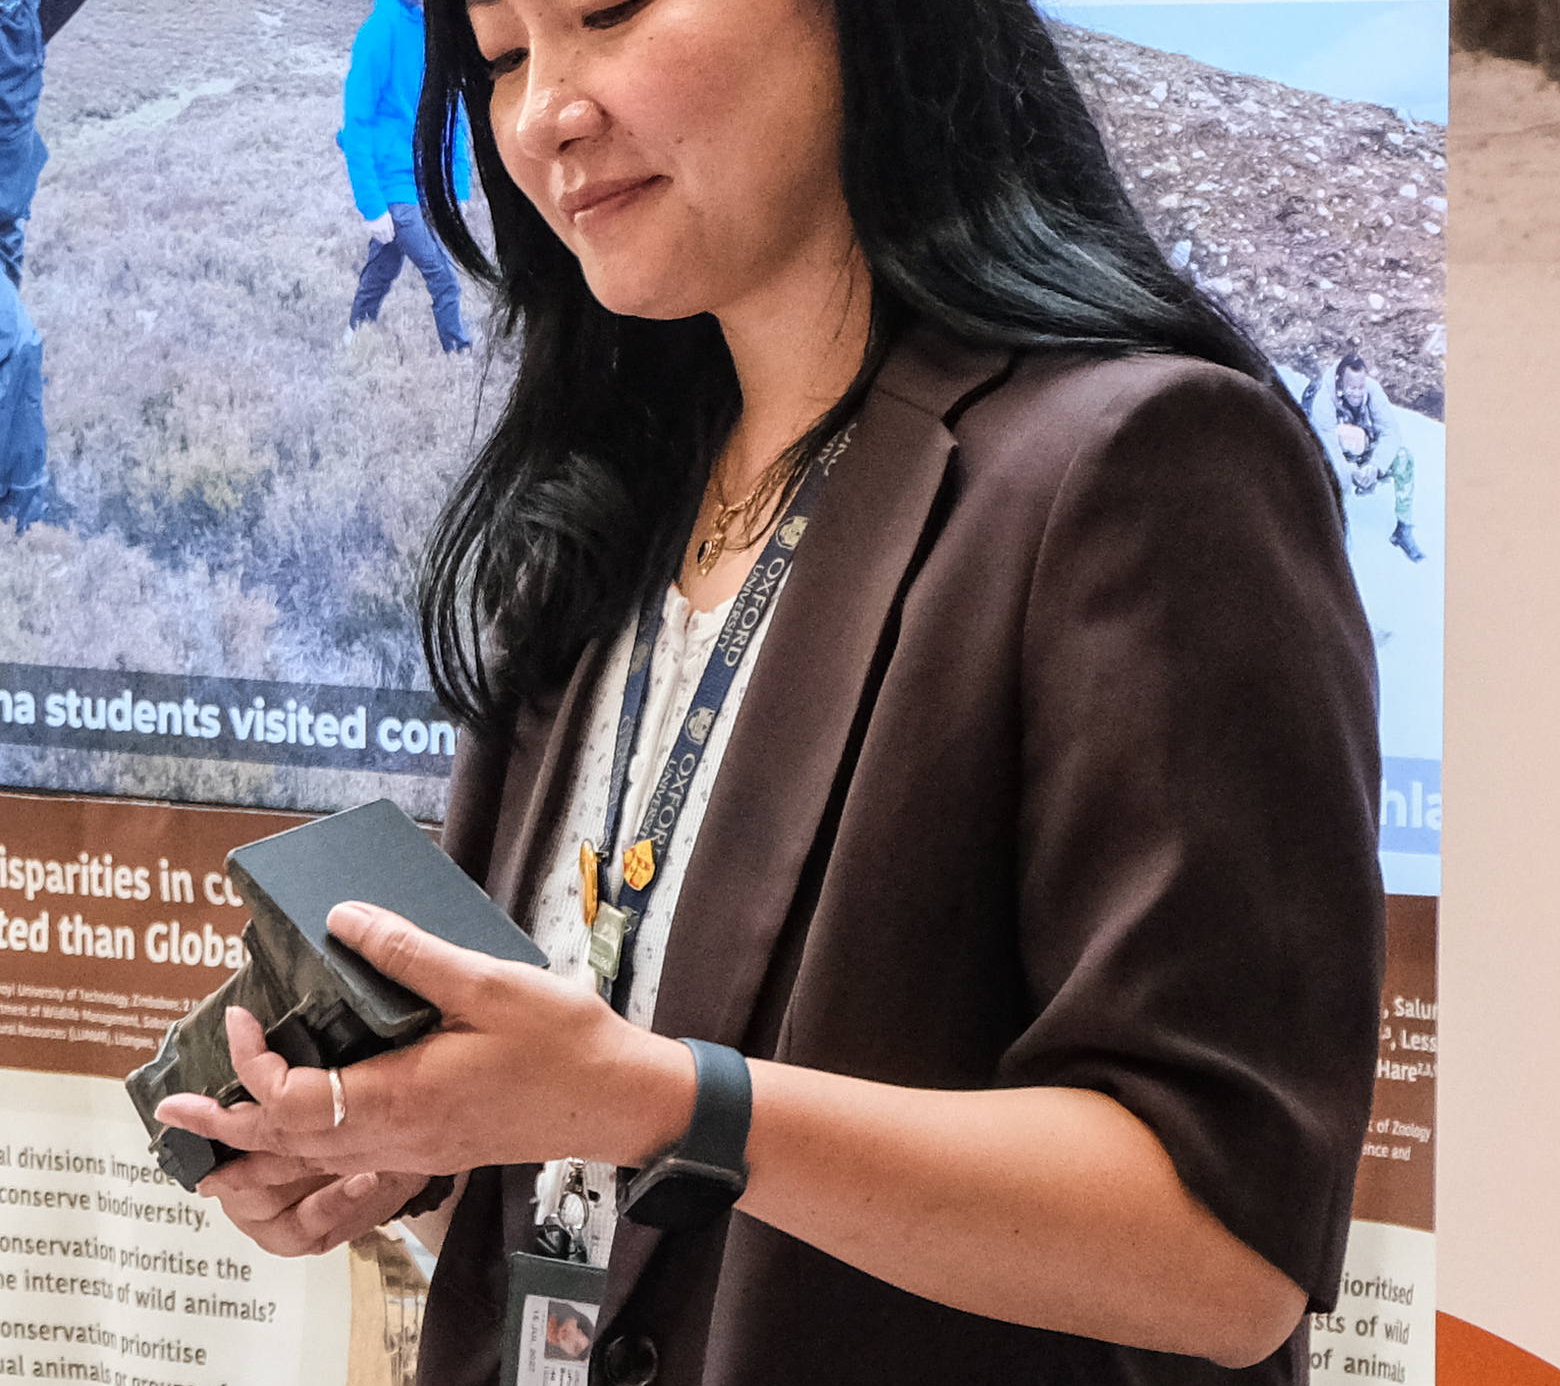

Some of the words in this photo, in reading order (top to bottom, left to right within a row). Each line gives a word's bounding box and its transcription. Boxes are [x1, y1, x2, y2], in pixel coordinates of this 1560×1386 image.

[718, 563, 765, 653] UNIVERSITY
[723, 556, 786, 669] OXFORD
[45, 689, 221, 739] students
[230, 697, 367, 749] visited
[376, 717, 459, 756] con
[652, 752, 697, 862] OXFOR
[159, 858, 194, 904] in
[58, 913, 136, 961] than
[145, 922, 254, 969] Globa
[18, 1146, 107, 1176] divisions
[98, 1191, 211, 1232] biodiversity.
[120, 1247, 209, 1277] prioritise
[216, 1256, 253, 1283] the
[25, 1269, 114, 1300] interests
[117, 1282, 132, 1305] of
[135, 1287, 176, 1312] wild
[184, 1294, 277, 1324] animals?
[120, 1330, 208, 1366] prioritise
[1384, 1318, 1411, 1346] wild
[32, 1357, 112, 1384] animals
[1343, 1352, 1407, 1385] animals
